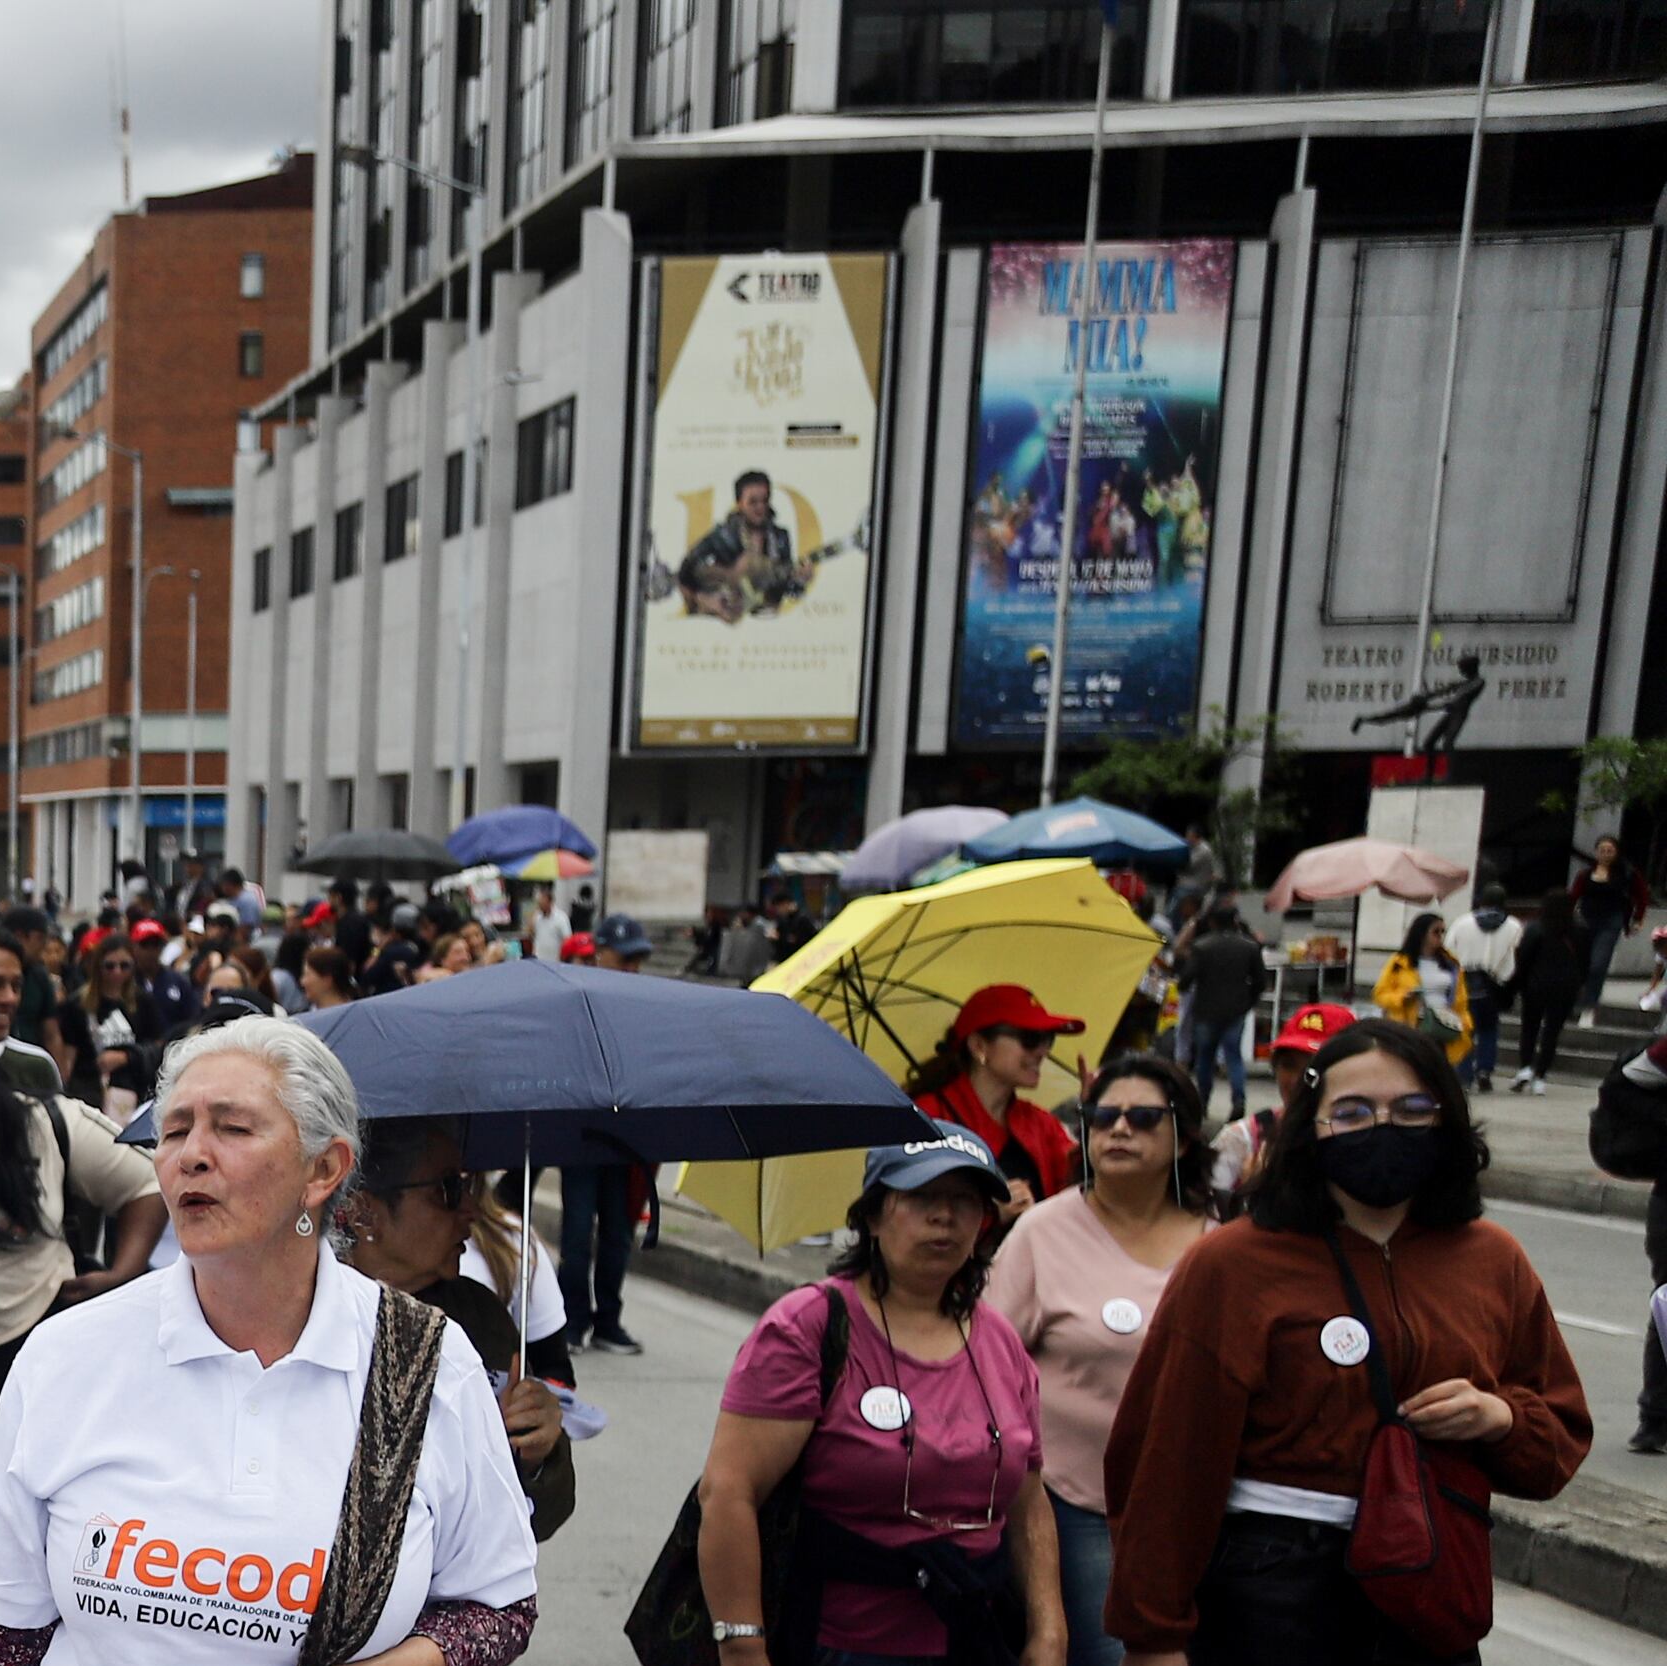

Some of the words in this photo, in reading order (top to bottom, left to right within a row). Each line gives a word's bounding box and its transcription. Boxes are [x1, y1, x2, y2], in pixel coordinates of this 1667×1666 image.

[1323, 645, 1403, 667] TEATRO
[1419, 645, 1558, 667] OLUBSIDIO
[1305, 679, 1404, 701] ROBERTO
[1498, 678, 1568, 699] PEREZ
[104, 1518, 327, 1615] fecod
[73, 1576, 122, 1593] FEDERACIÓN
[124, 1586, 187, 1604] COLOMBIANA
[190, 1596, 203, 1606] DE
[205, 1599, 281, 1620] TRABAJADORES
[283, 1612, 296, 1623] DE
[75, 1591, 128, 1623] VIDA,
[136, 1603, 282, 1644] EDUCACIÓN
[289, 1629, 306, 1648] Y
